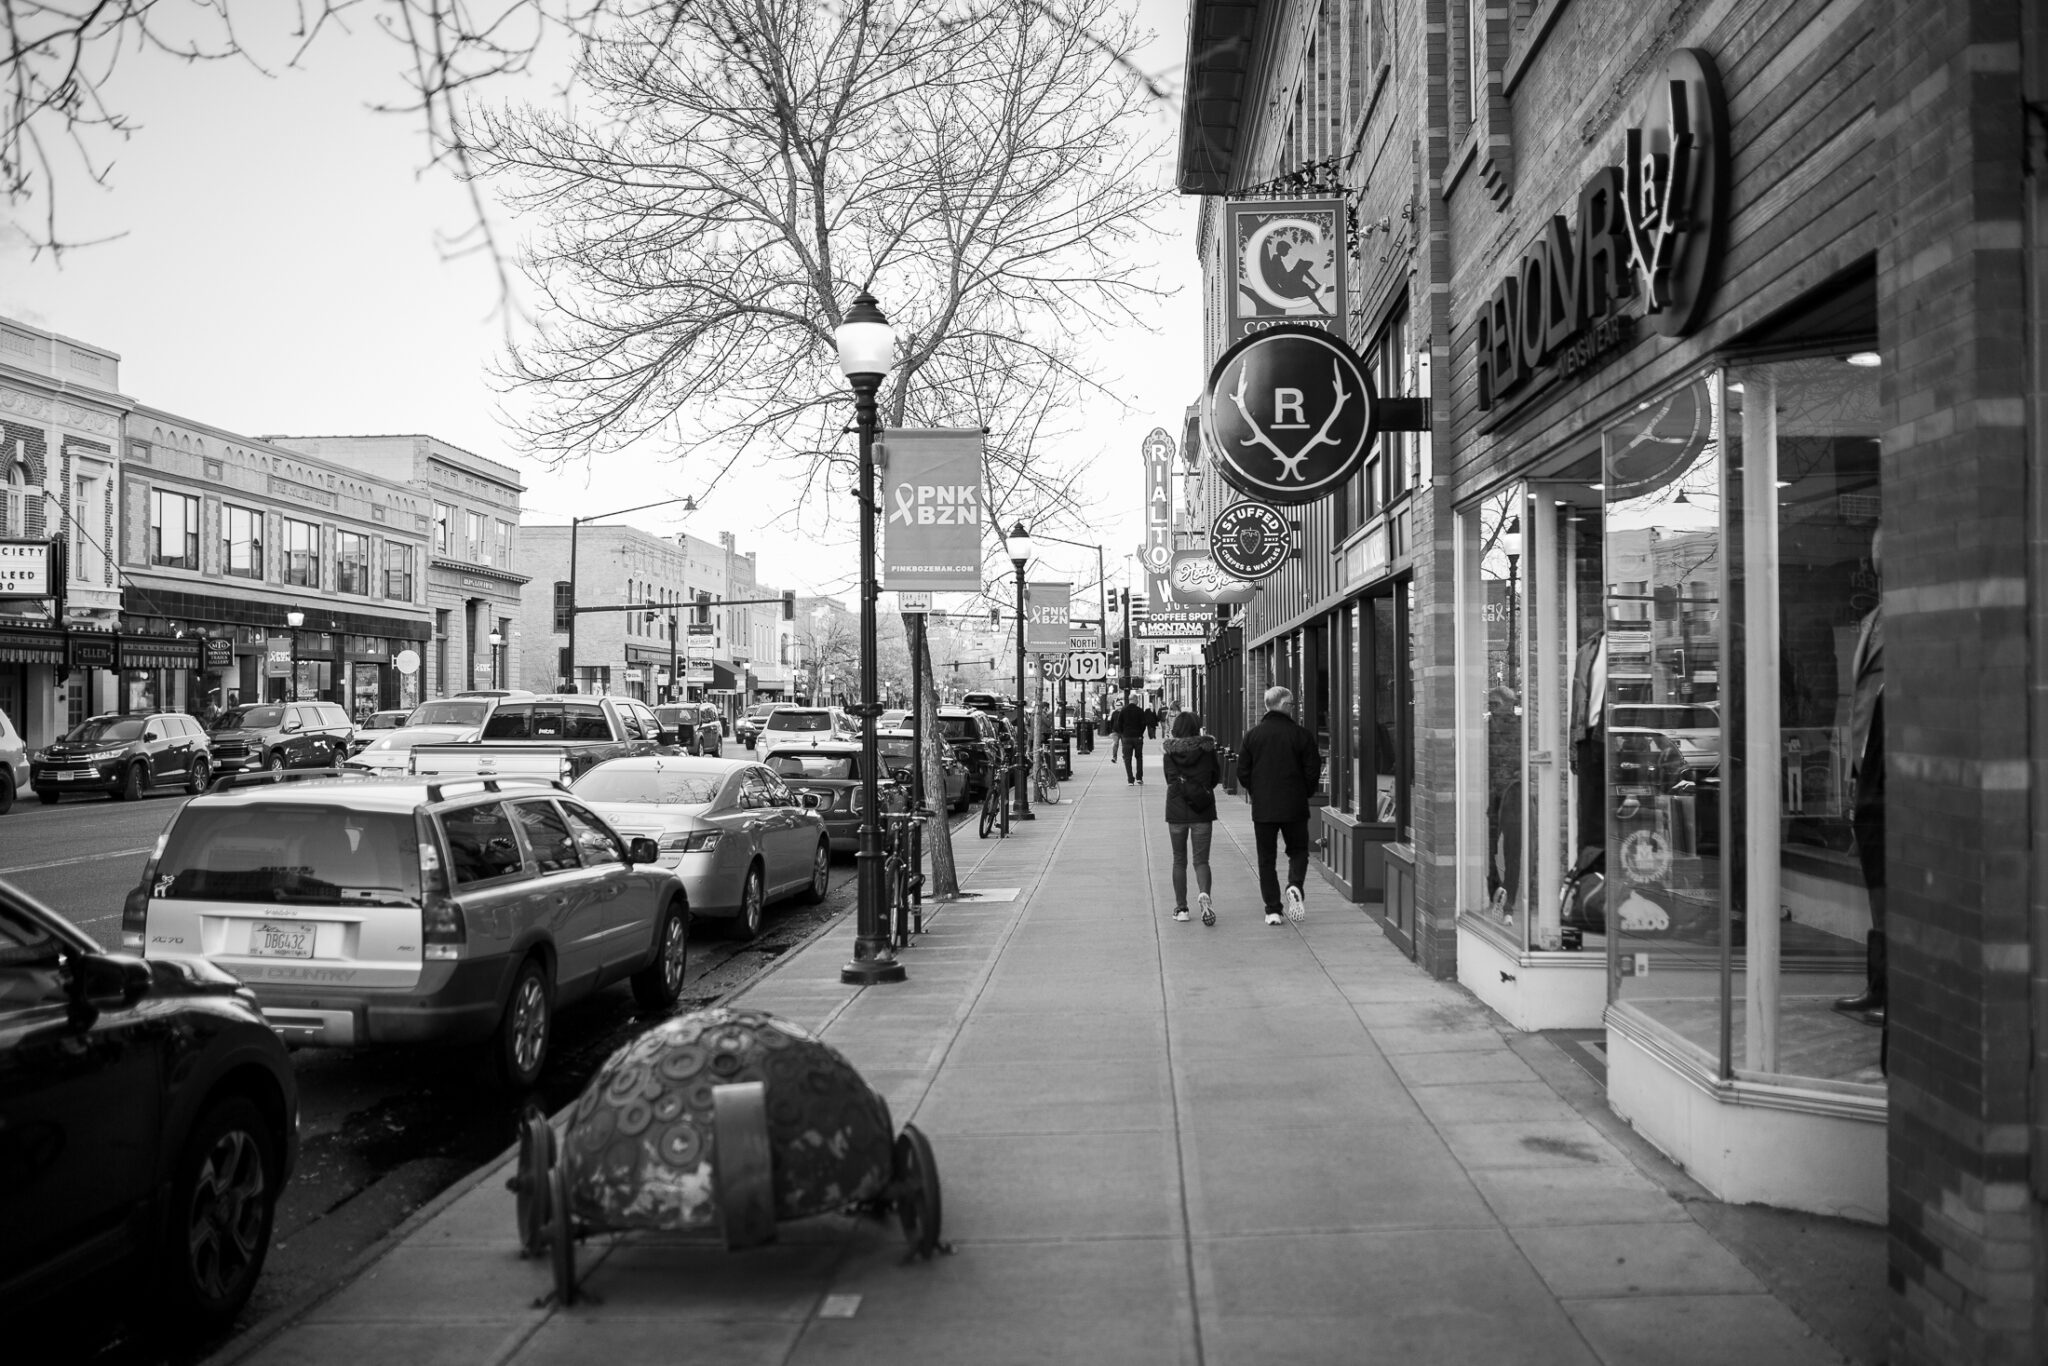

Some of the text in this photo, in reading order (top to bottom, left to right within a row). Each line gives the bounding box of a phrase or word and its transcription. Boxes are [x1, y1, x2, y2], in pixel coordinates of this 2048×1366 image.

[1275, 387, 1306, 424] R
[917, 485, 977, 505] PNK
[1151, 444, 1168, 565] RIALTO
[917, 506, 977, 525] BZN
[1222, 507, 1279, 531] STUFFED
[1221, 549, 1245, 571] CREPES
[1042, 606, 1068, 615] PNK
[1150, 612, 1213, 621] COFFEE SPOT
[1042, 616, 1068, 624] BZN
[1147, 622, 1203, 631] MONTANA
[1070, 638, 1097, 648] NORTH
[1043, 662, 1063, 677] 90
[1076, 658, 1099, 674] 191
[264, 932, 305, 951] DBG432
